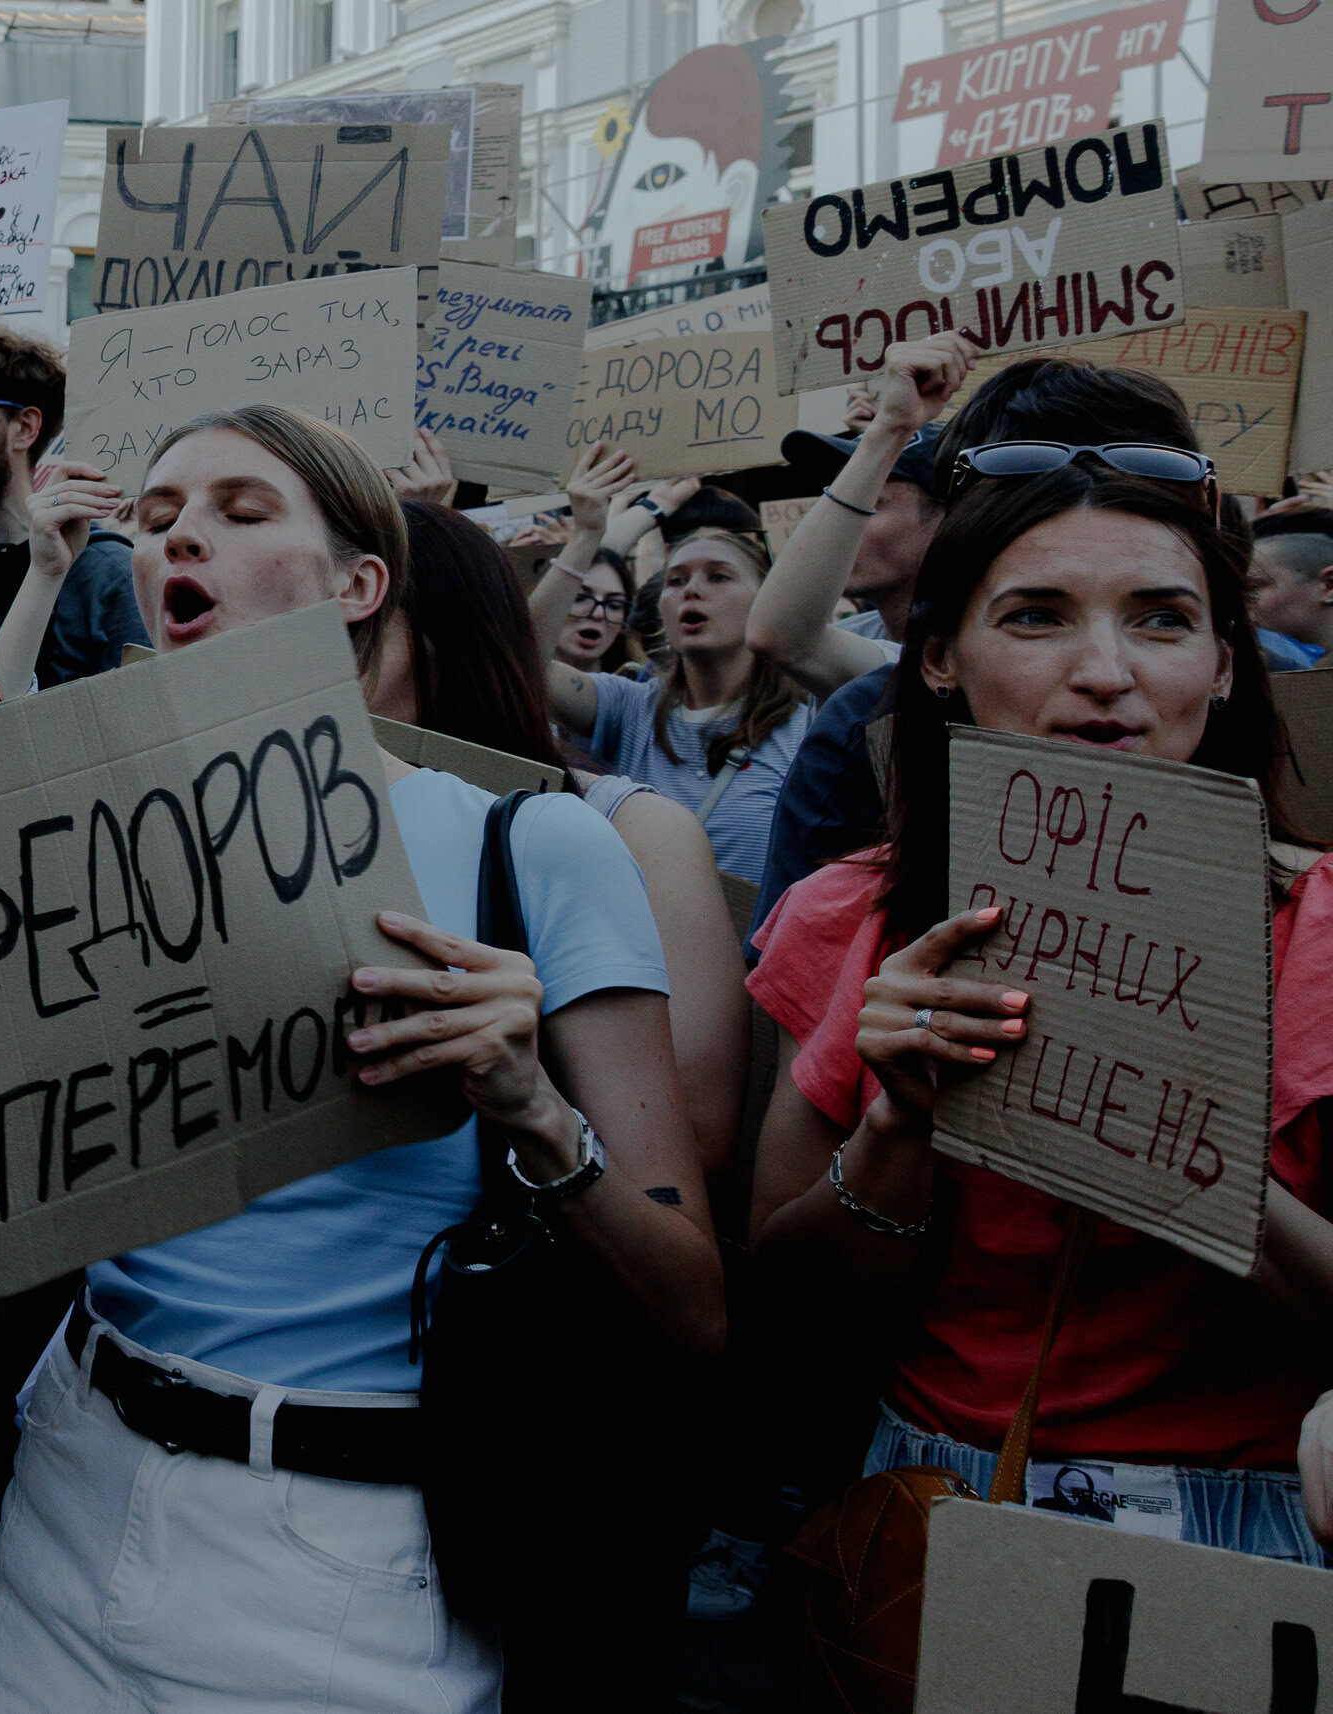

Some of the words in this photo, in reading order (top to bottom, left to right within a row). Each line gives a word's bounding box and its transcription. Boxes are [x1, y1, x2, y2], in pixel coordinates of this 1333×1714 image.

[956, 25, 1103, 104] КОРПУС
[116, 125, 409, 254] ЧАЙ
[803, 123, 1163, 257] ПОМРЕМО
[918, 217, 1062, 294] АБО
[98, 329, 133, 384] Я
[187, 312, 290, 354] ГОЛОС
[319, 300, 400, 327] ТИХ,
[133, 368, 197, 400] ХТО
[246, 339, 361, 381] ЗАРАЗ
[583, 347, 761, 402] ДОРОВА
[695, 396, 762, 440] МО
[998, 769, 1150, 897] ОФІС
